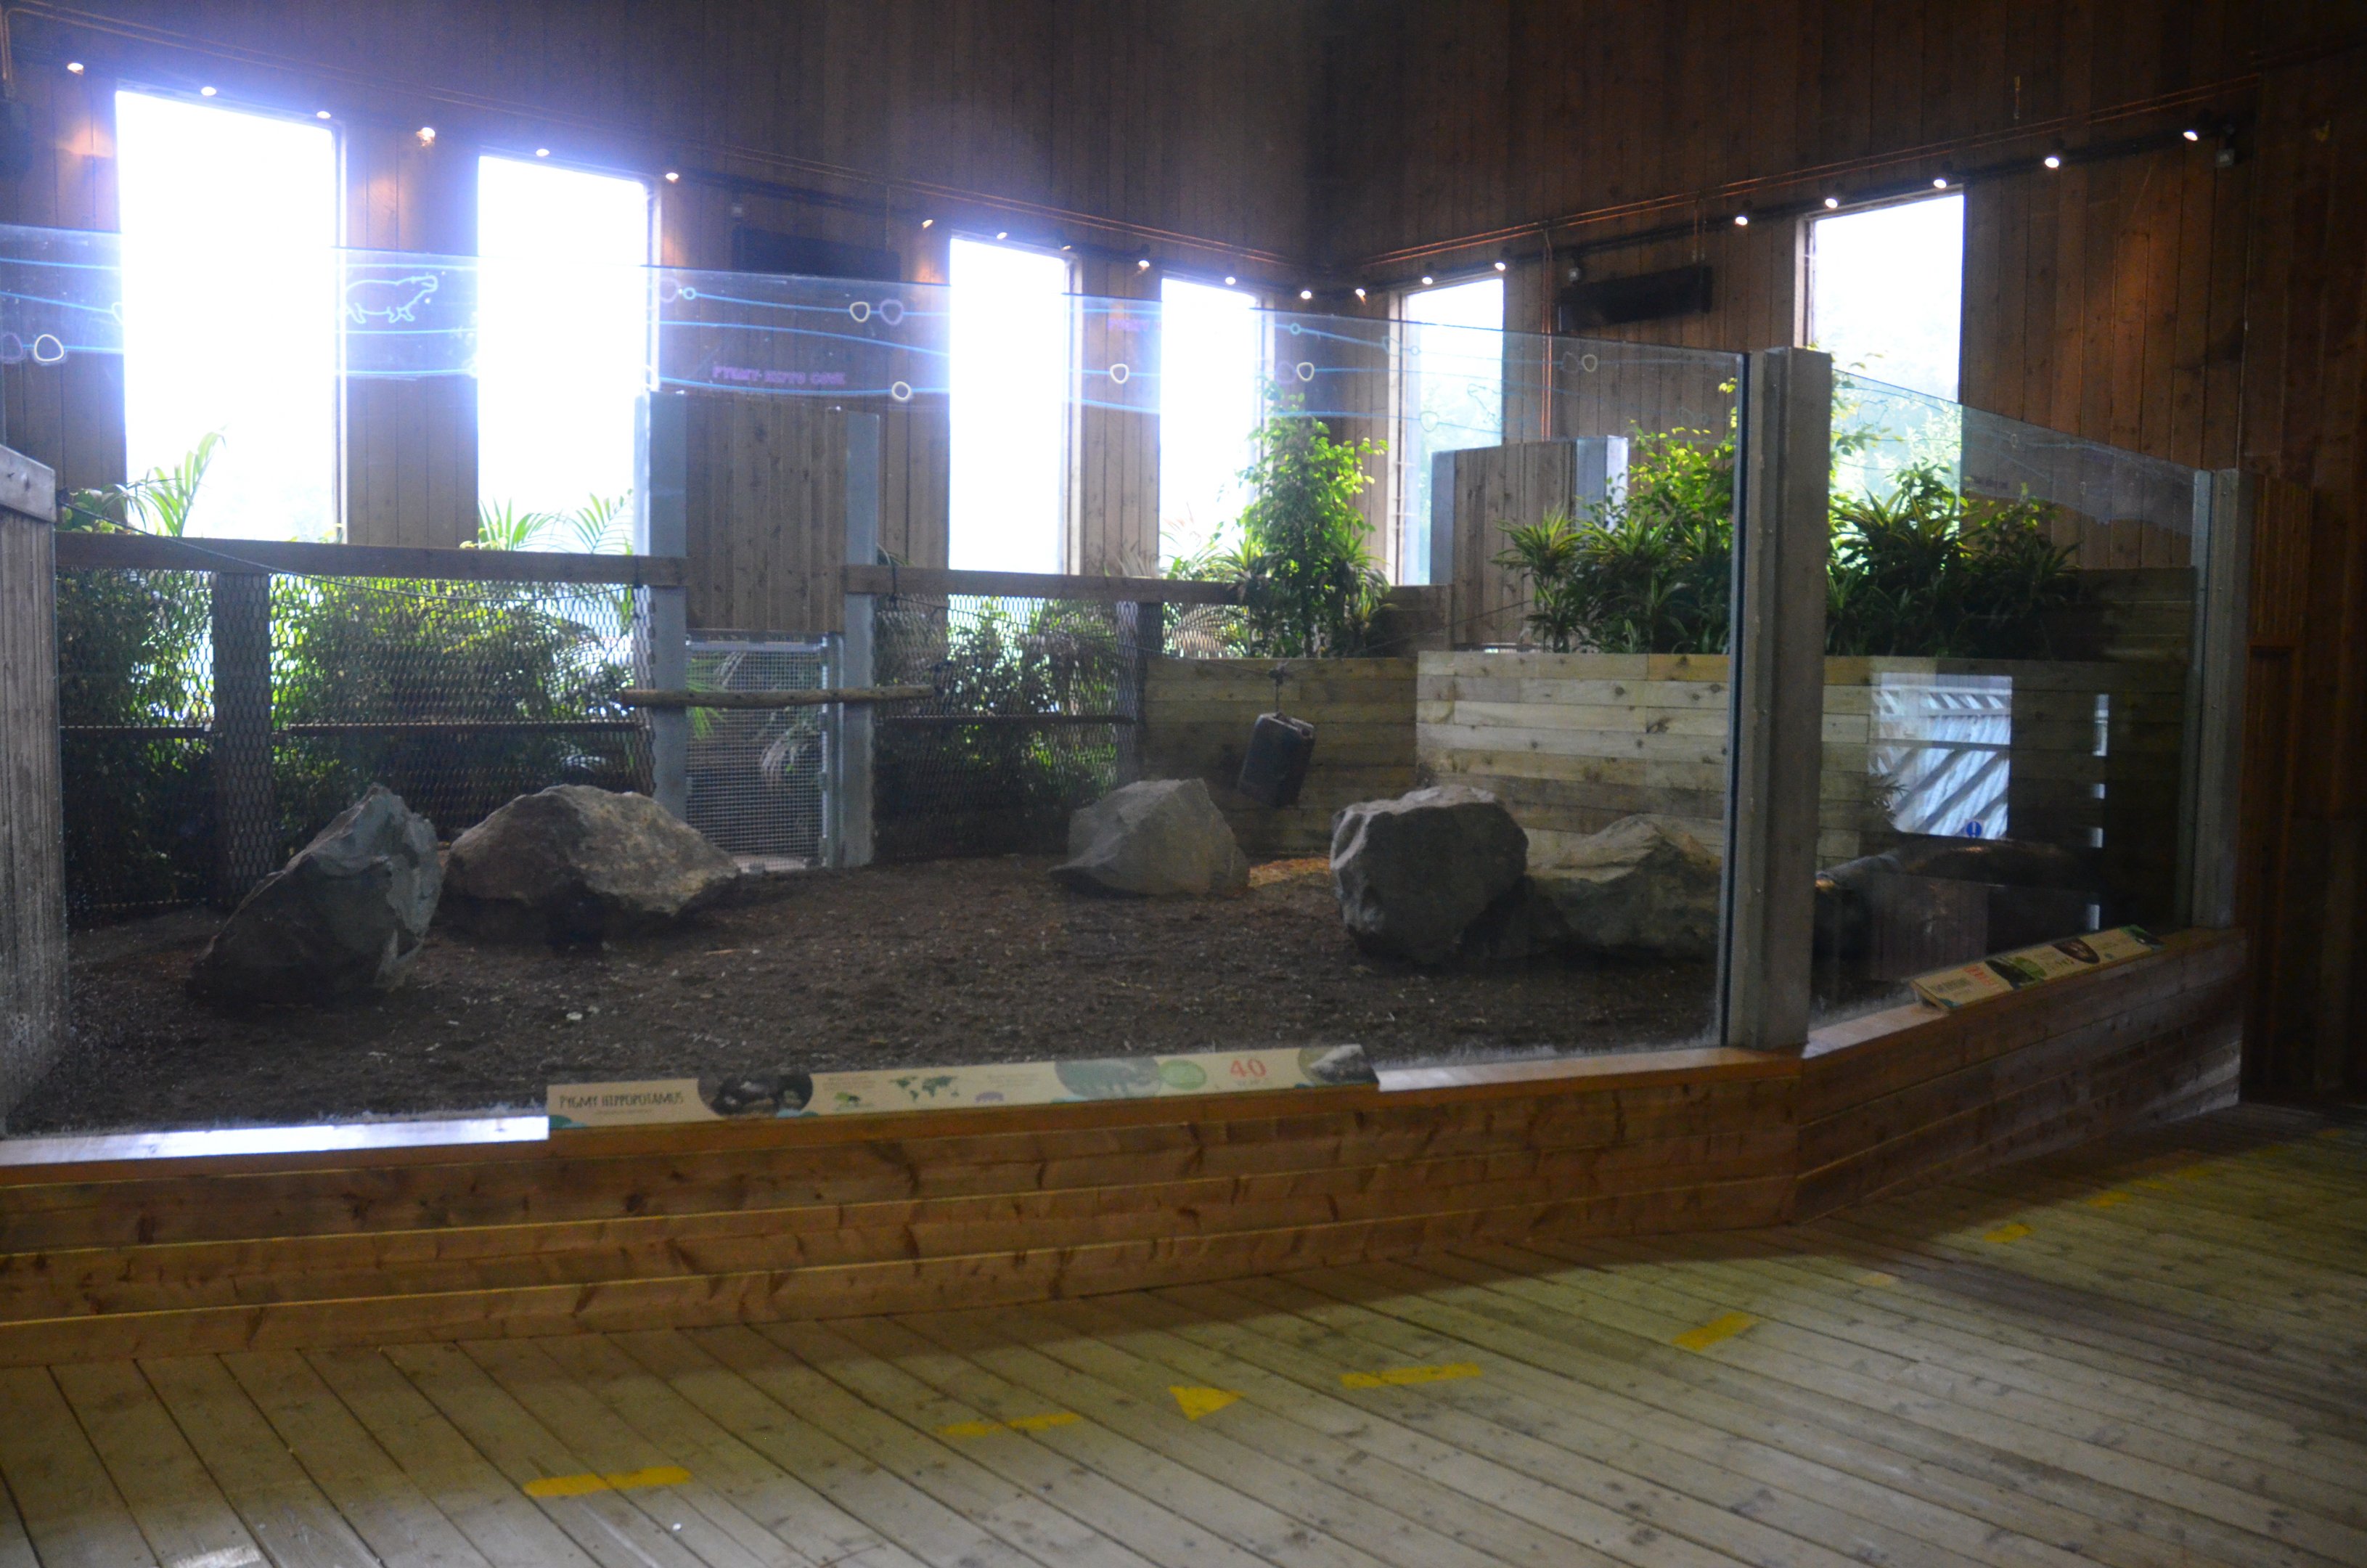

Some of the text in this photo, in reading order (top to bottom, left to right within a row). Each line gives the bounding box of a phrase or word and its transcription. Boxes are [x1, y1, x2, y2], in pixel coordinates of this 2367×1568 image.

[1230, 1058, 1267, 1078] 40
[559, 1091, 684, 1108] PYGMY HIPPOPOTAMUS
